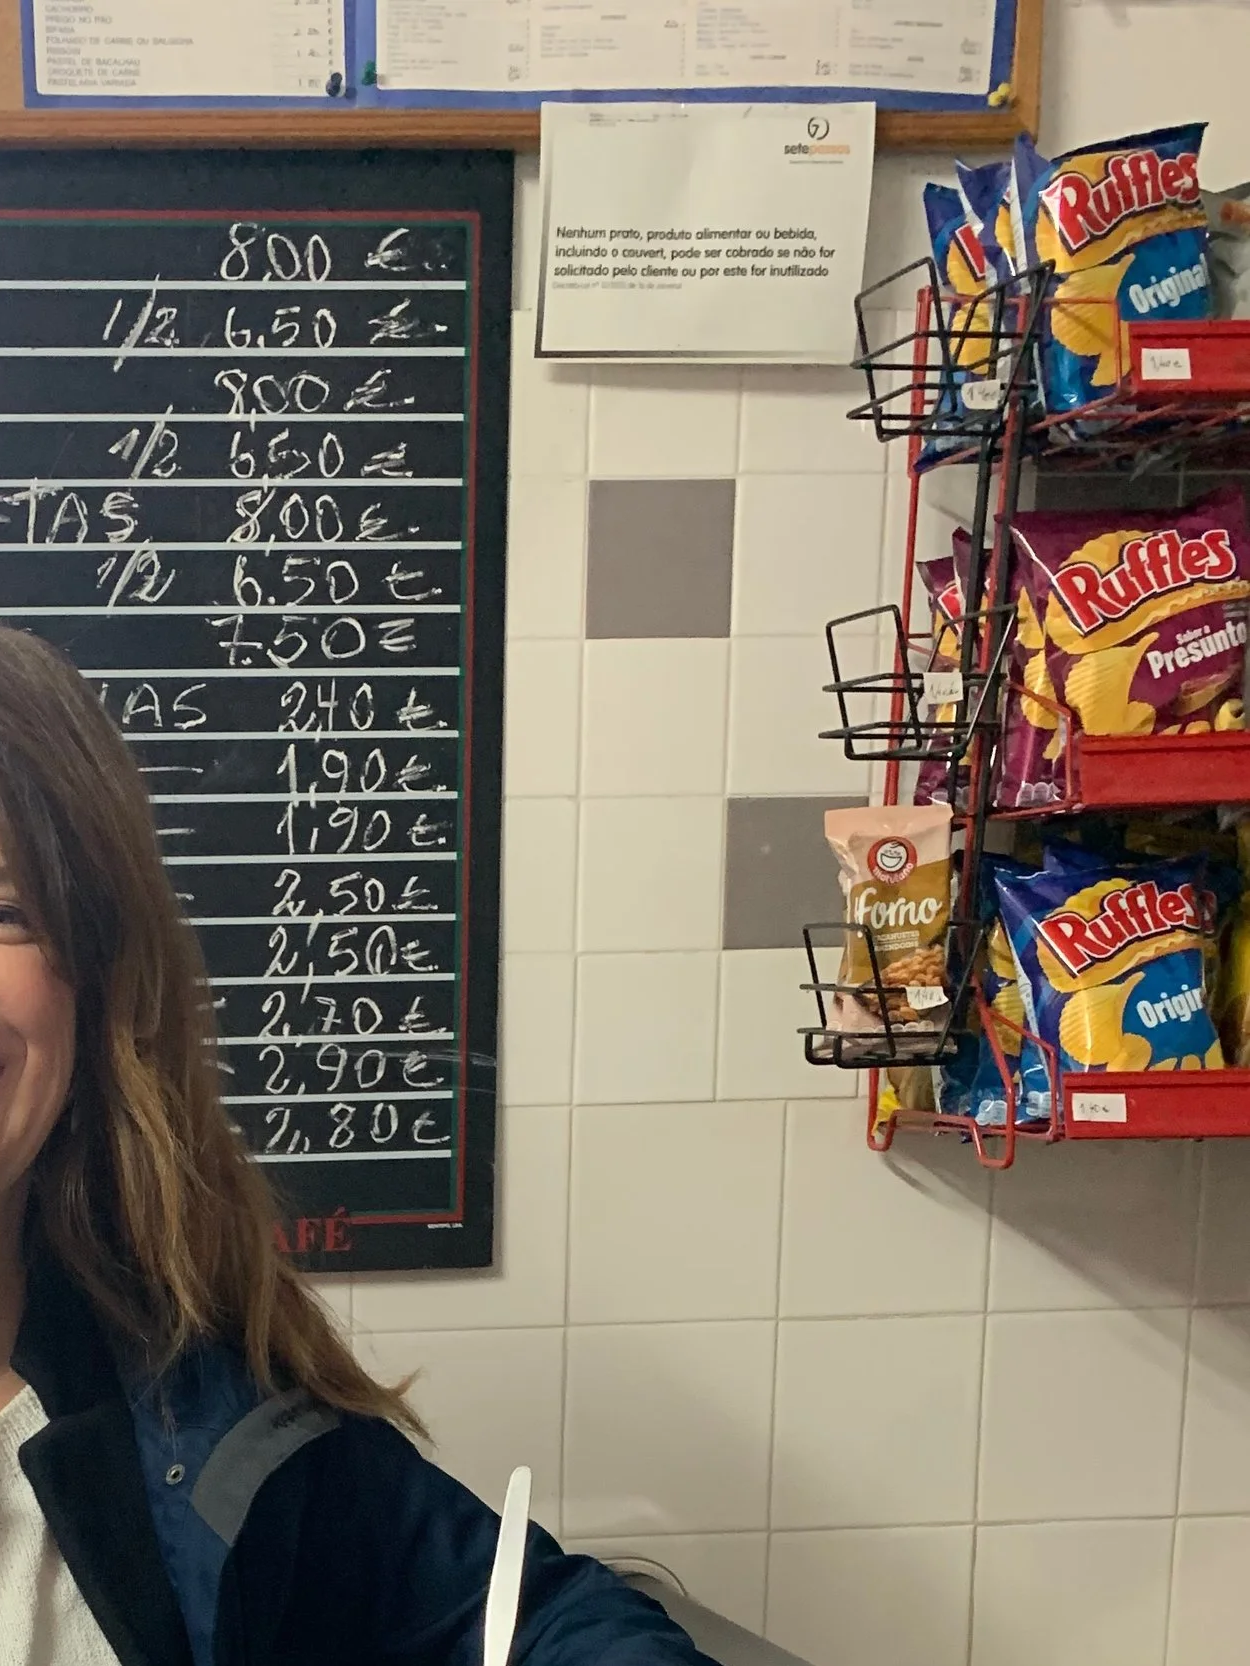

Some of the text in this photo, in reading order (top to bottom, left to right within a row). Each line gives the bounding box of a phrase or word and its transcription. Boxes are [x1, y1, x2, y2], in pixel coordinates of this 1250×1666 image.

[1039, 150, 1201, 249] Ruffles
[555, 245, 836, 260] incluindo o couvert, pode ser cobrado se não for
[556, 226, 818, 242] Nenhum prato, produto alimentar ou bebida,
[554, 264, 830, 279] solicitado pelo cliente ou por este for inutilizado
[1129, 252, 1209, 314] Original
[102, 274, 180, 373] 1/2
[107, 404, 181, 480] 1/2
[97, 537, 176, 609] 1/2
[1053, 529, 1236, 633] Ruffles
[1146, 621, 1247, 679] Presunto
[1038, 881, 1216, 976] Ruffles
[273, 1205, 351, 1253] AFÉ
